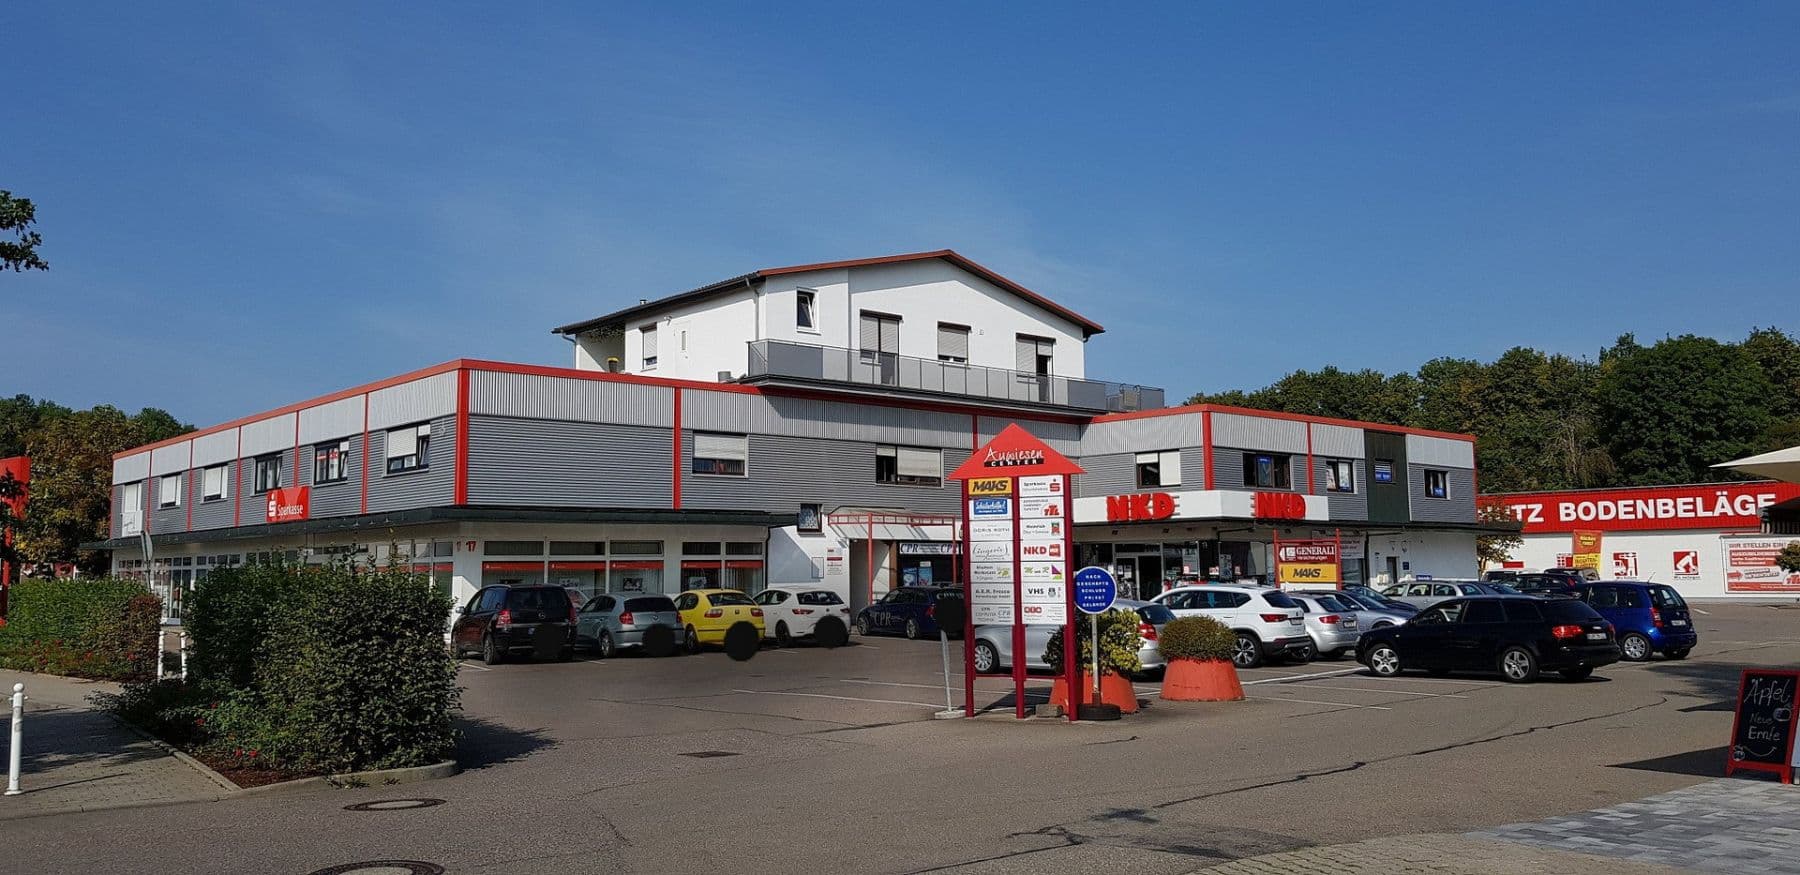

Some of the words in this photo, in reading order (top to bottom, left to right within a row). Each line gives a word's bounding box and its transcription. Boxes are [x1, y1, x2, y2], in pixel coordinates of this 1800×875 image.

[991, 459, 1037, 467] CENTER
[973, 480, 1008, 492] MAKS
[1106, 492, 1175, 522] NKD
[1256, 491, 1306, 519] NKD
[901, 543, 919, 553] CPR
[1024, 547, 1047, 555] NKD
[1296, 546, 1335, 556] GENERALI
[1293, 568, 1321, 578] MAKS
[1744, 678, 1791, 706] Äpfel
